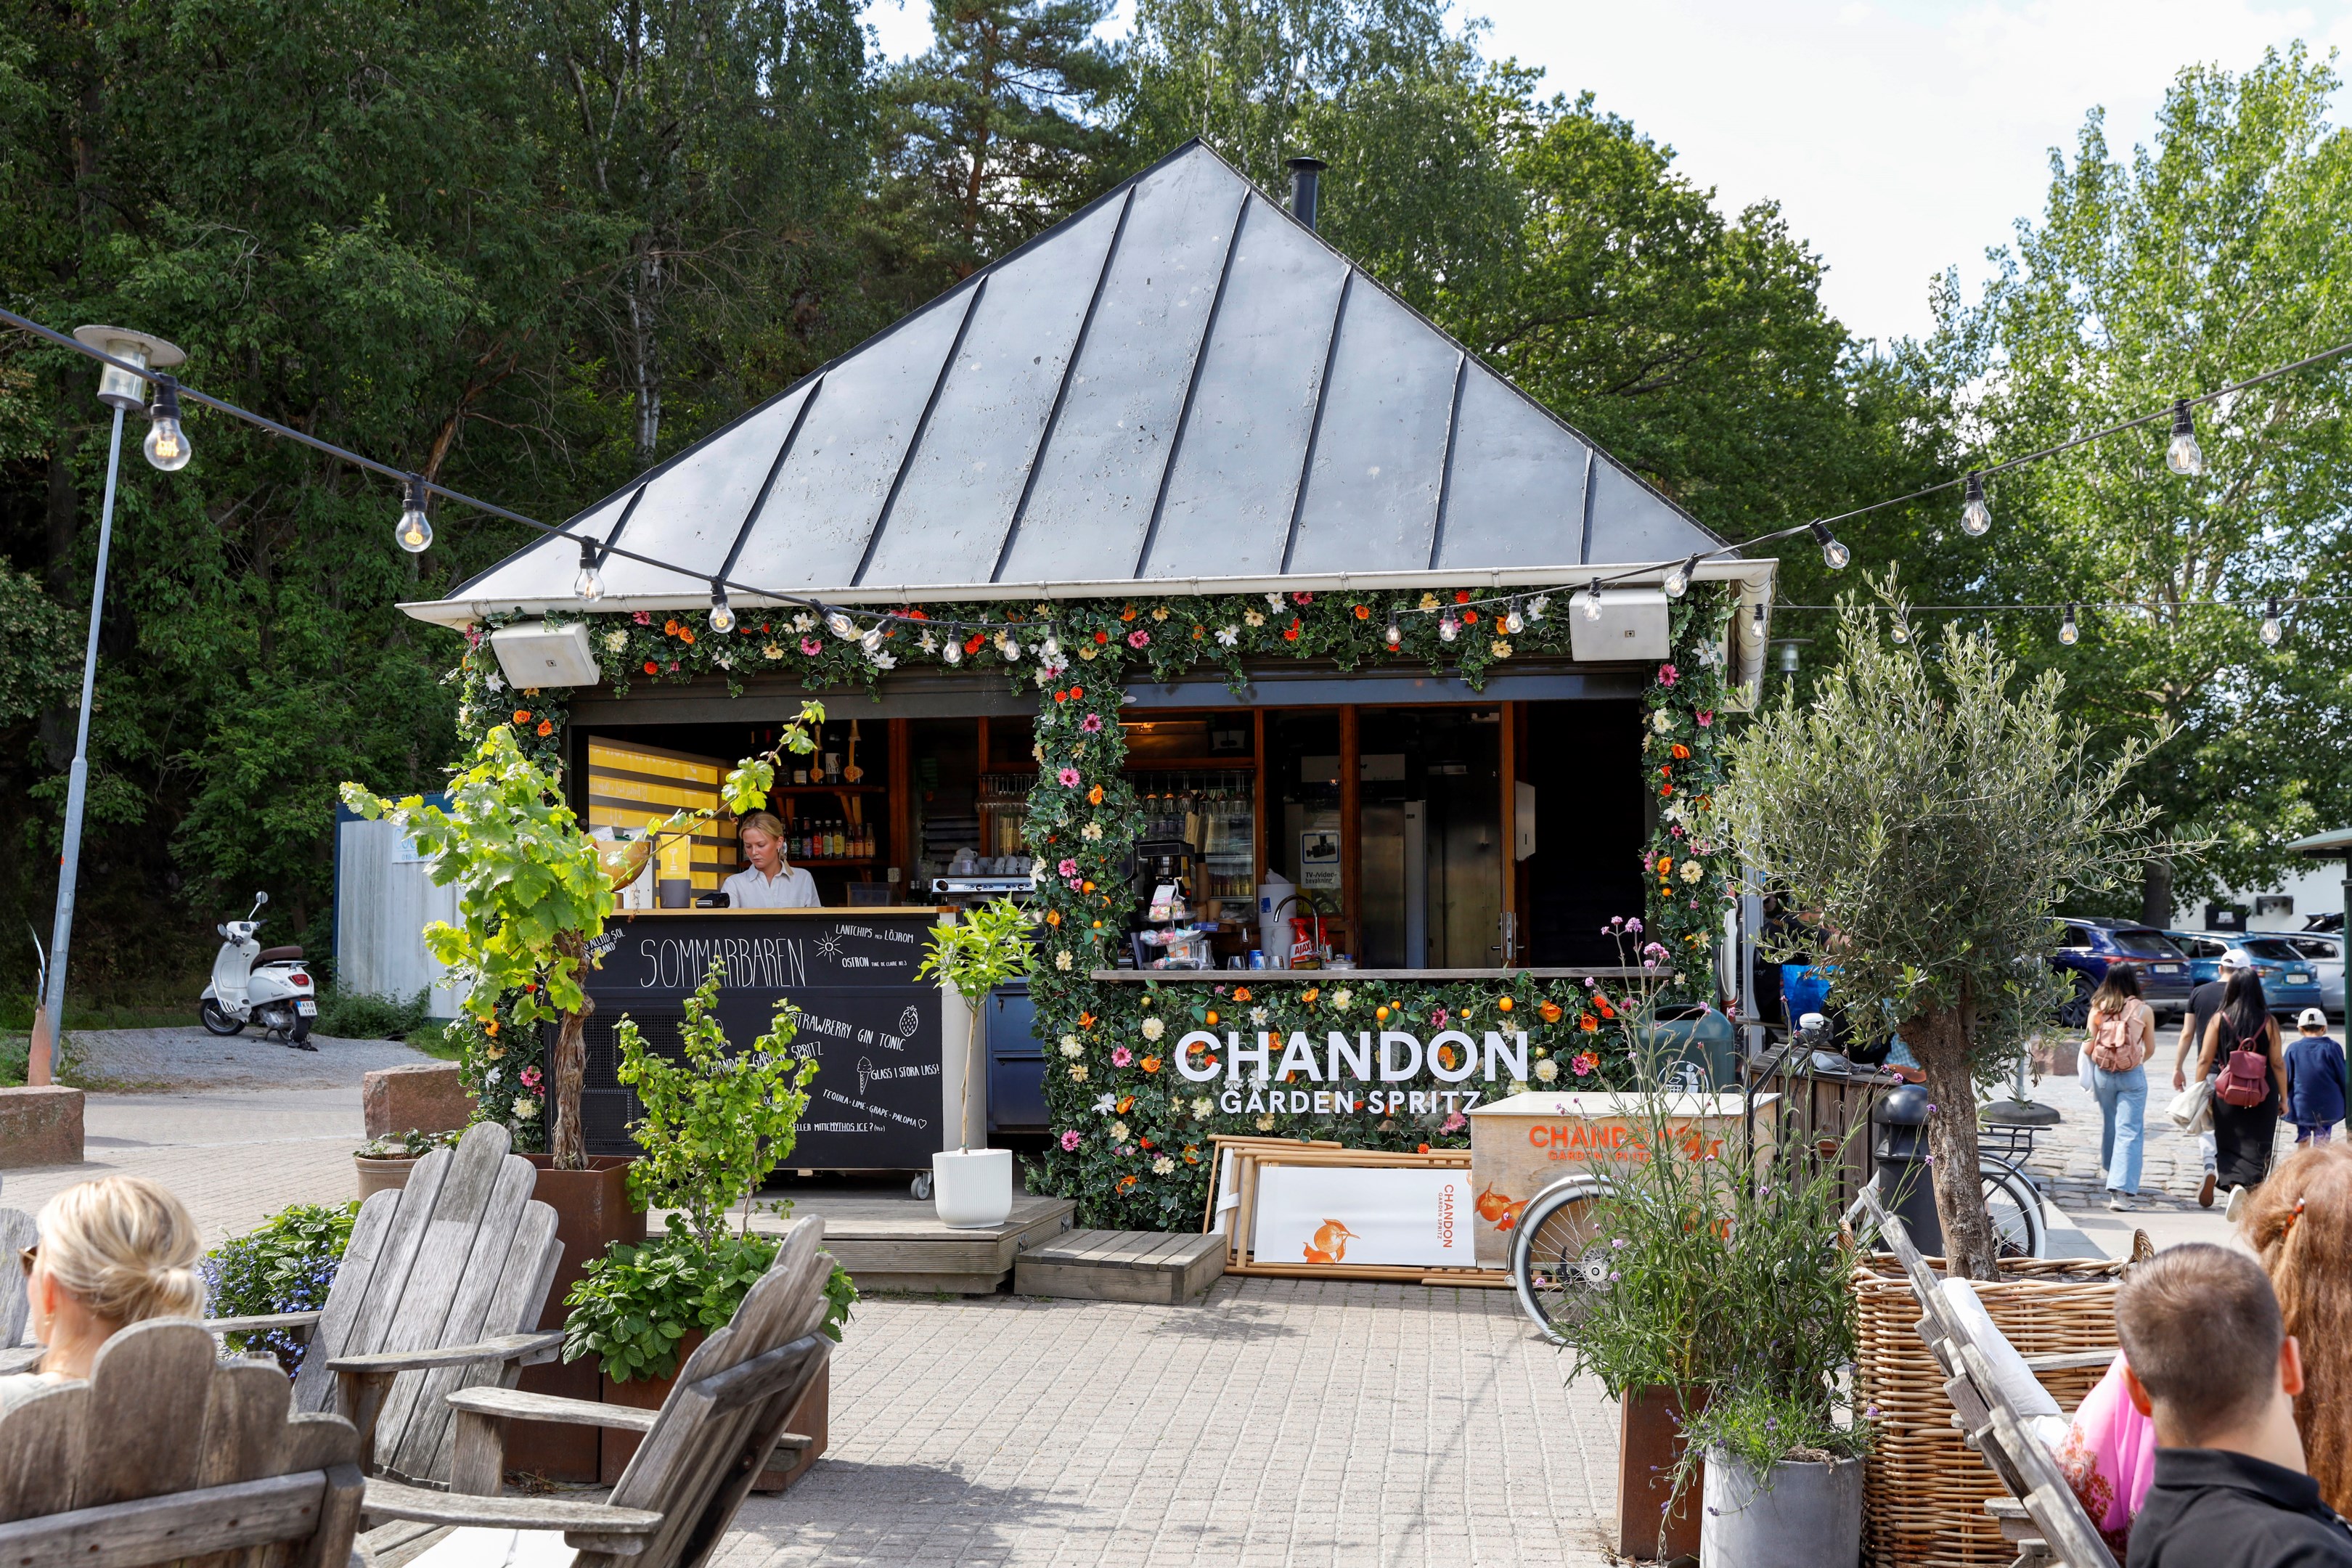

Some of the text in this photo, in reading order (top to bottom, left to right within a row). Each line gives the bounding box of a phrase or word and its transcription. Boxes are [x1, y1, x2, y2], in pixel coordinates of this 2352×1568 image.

[611, 928, 626, 940] SOL
[836, 924, 873, 938] LANTCHIPS
[884, 929, 914, 944] LÖJROM
[1294, 942, 1311, 955] AJAX
[640, 938, 806, 988] SOMMARBAREN
[788, 1011, 907, 1051] STRAWBERRY GIN TONIC
[791, 1041, 824, 1061] SPRITZ
[1175, 1030, 1529, 1082] CHANDON
[871, 1063, 941, 1080] GLASS I STORA LASS!
[822, 1089, 917, 1127] TEQUILA LIME GRAPE PALOMA
[1220, 1090, 1482, 1114] GARDEN SPRITZ
[793, 1123, 812, 1132] ELLER
[1442, 1184, 1454, 1248] CHANDON
